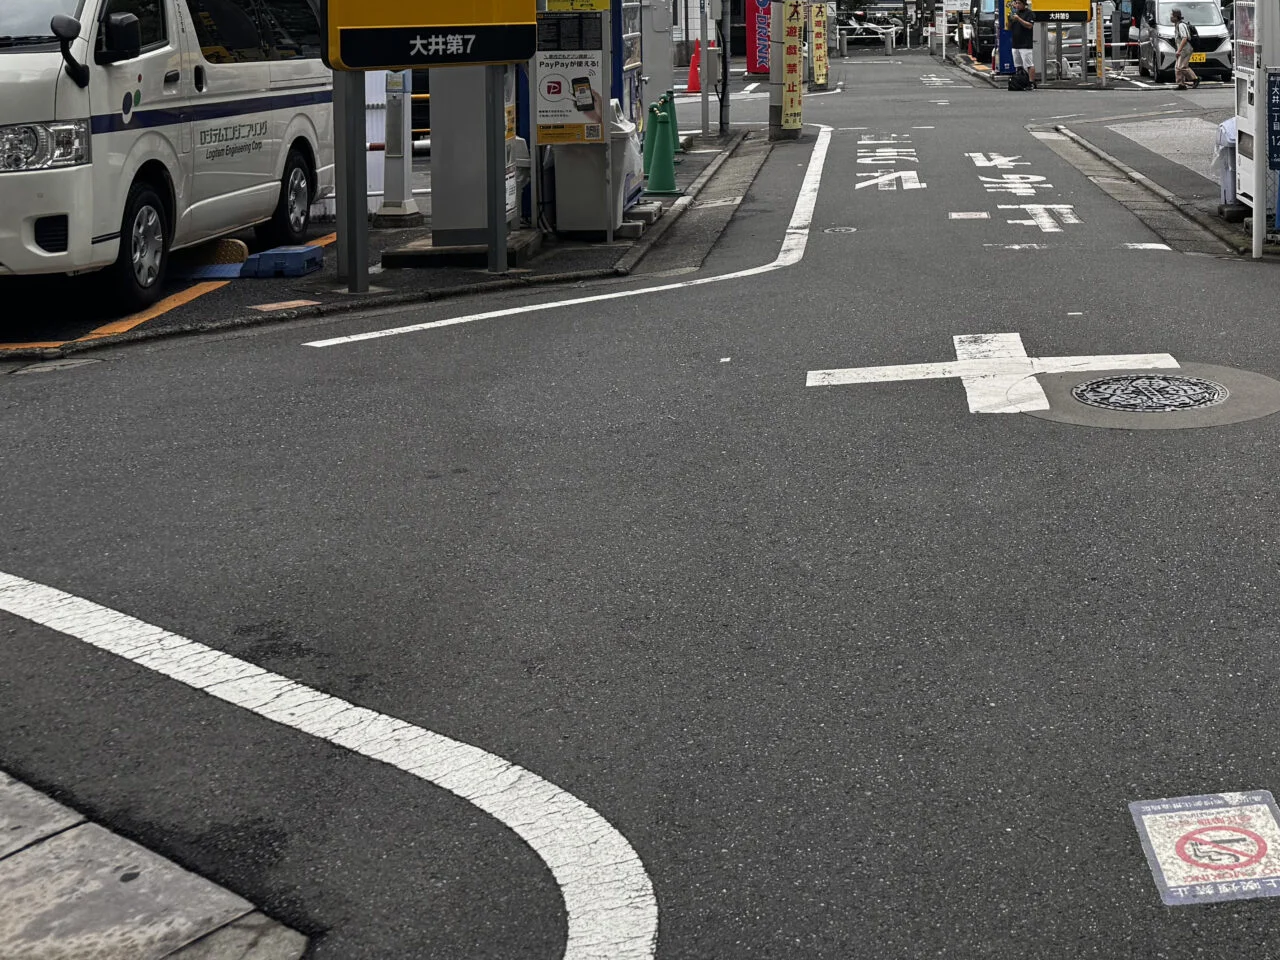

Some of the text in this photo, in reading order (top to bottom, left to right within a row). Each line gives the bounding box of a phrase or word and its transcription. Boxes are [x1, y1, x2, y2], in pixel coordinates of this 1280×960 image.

[409, 34, 476, 56] 大井第7
[1272, 85, 1280, 131] 大井一丁目
[200, 121, 268, 146] ロジテムエンジニアリング
[226, 143, 252, 157] Engineering
